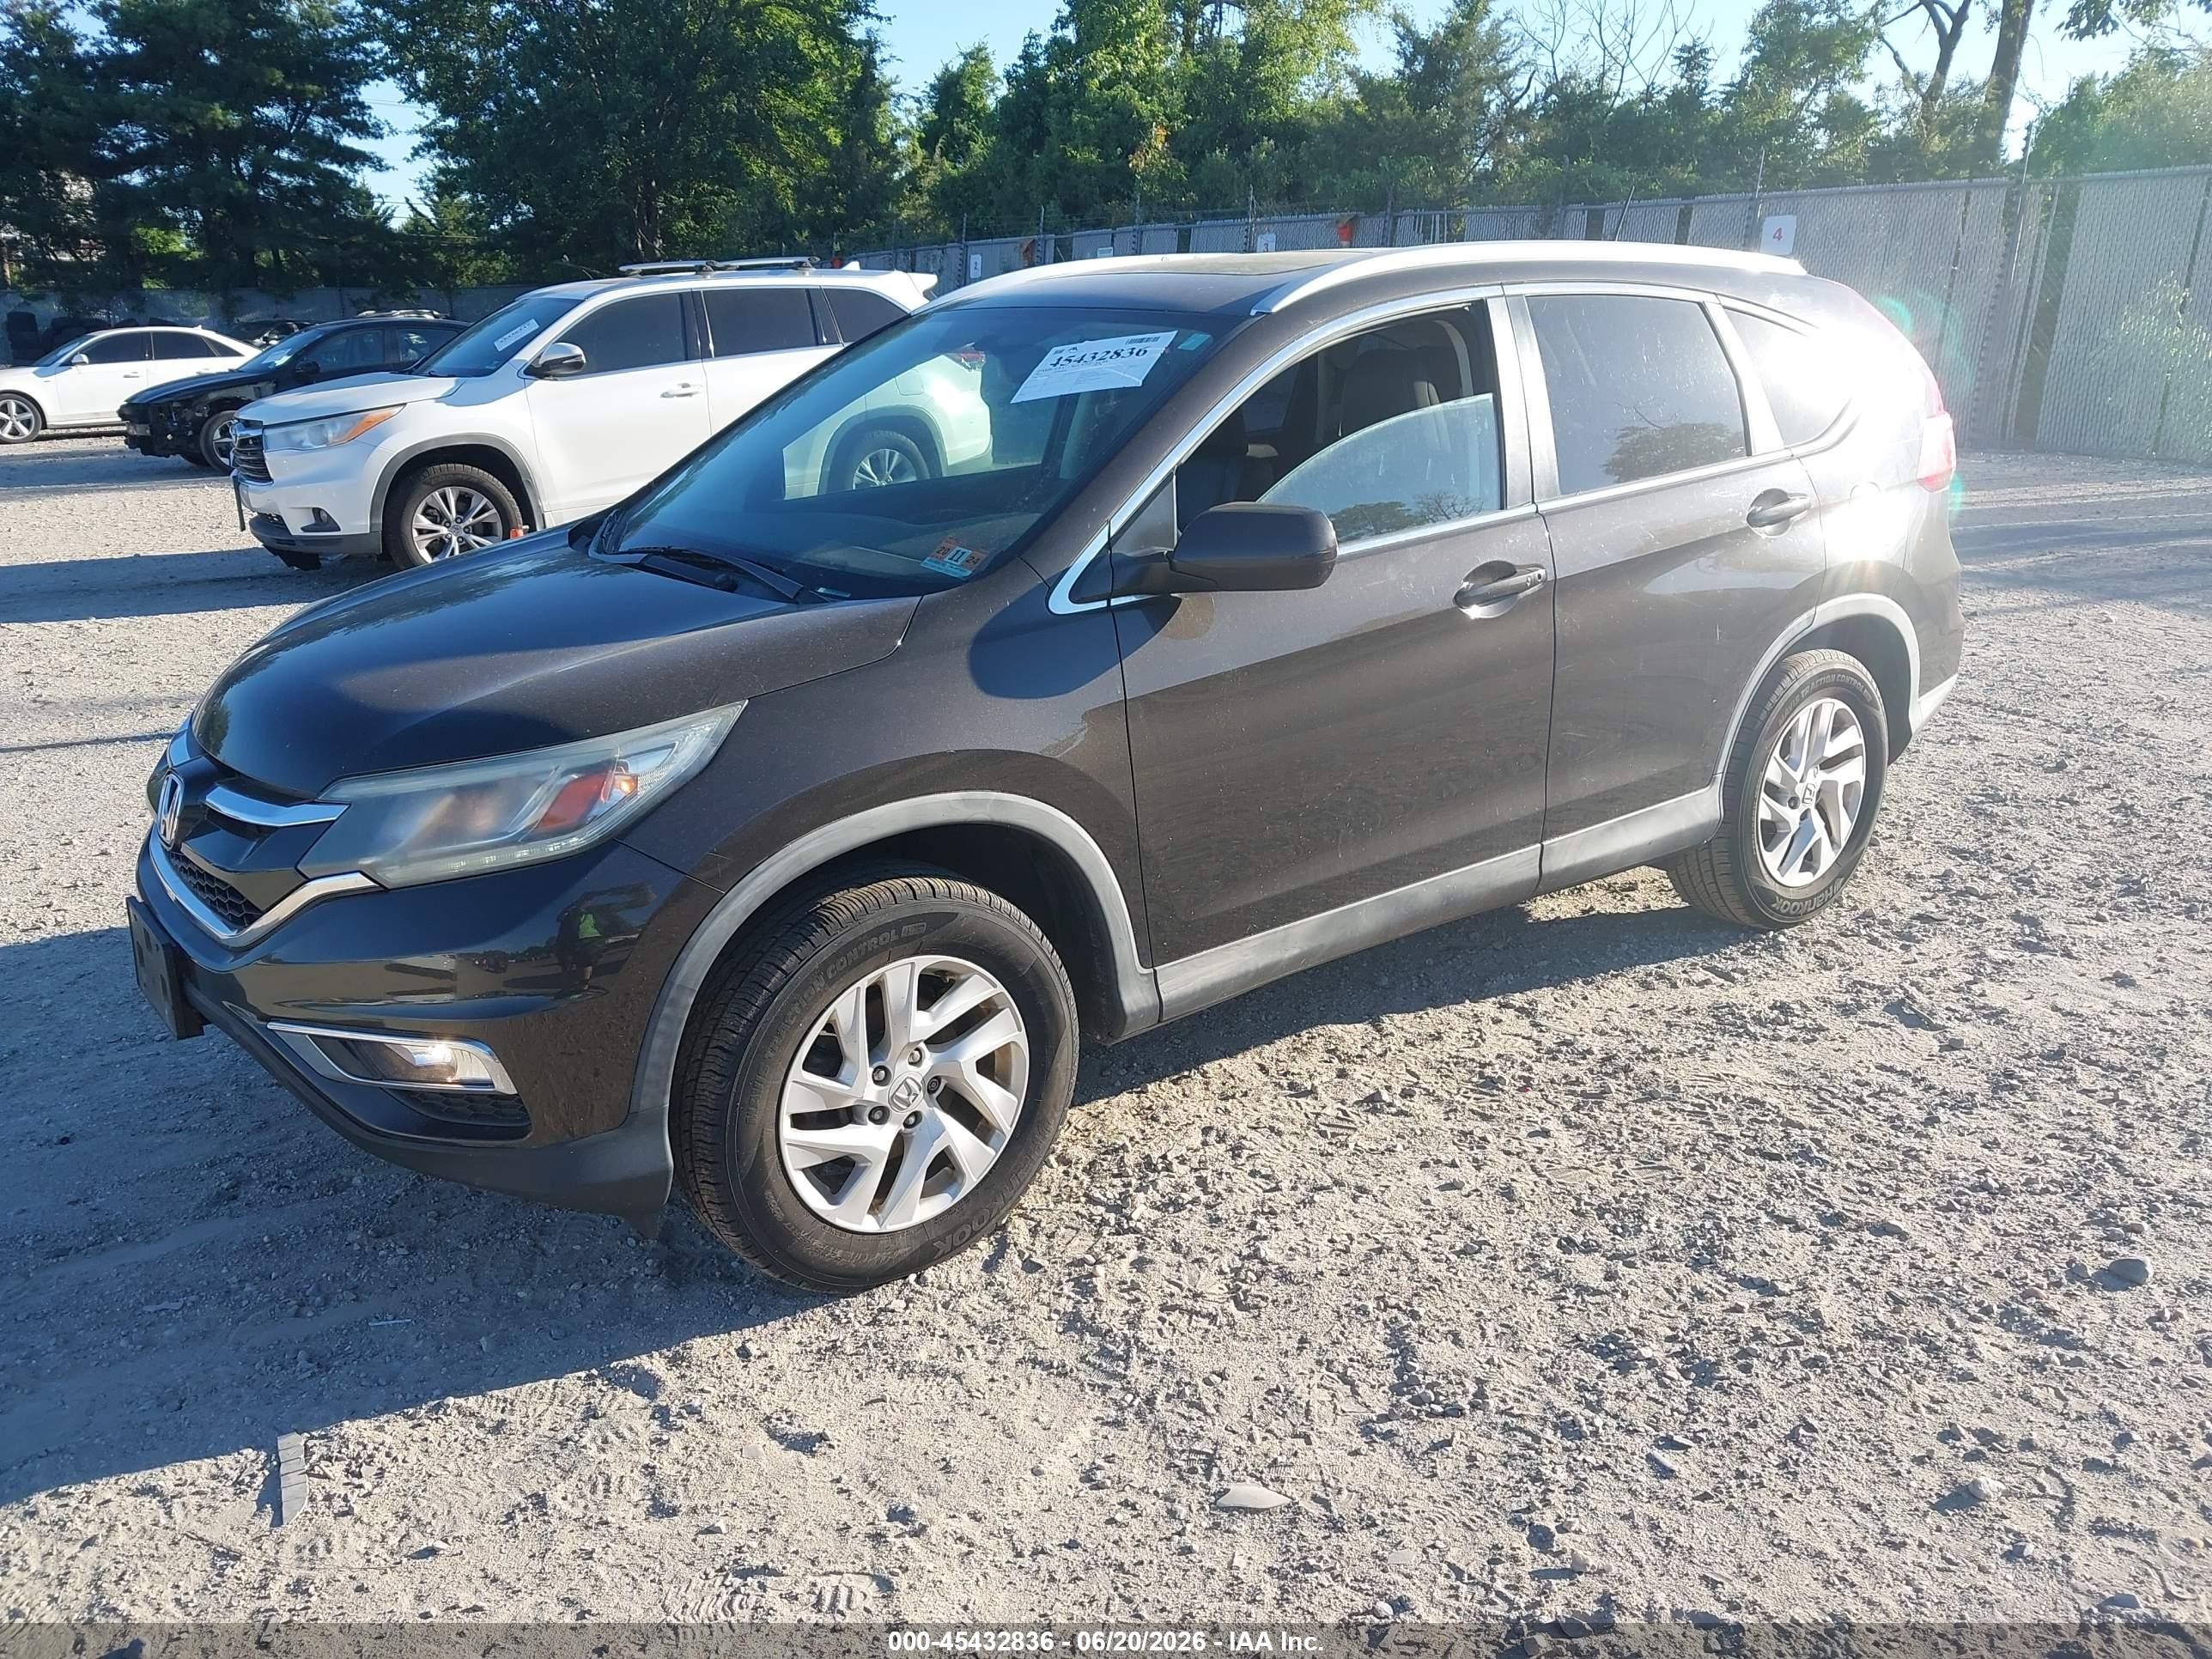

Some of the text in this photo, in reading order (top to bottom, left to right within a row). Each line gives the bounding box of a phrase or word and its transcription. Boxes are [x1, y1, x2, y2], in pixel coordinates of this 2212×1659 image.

[1772, 227, 1784, 241] 4
[1049, 346, 1149, 368] 45432836
[947, 550, 967, 563] 11
[825, 928, 899, 979] CONTROL
